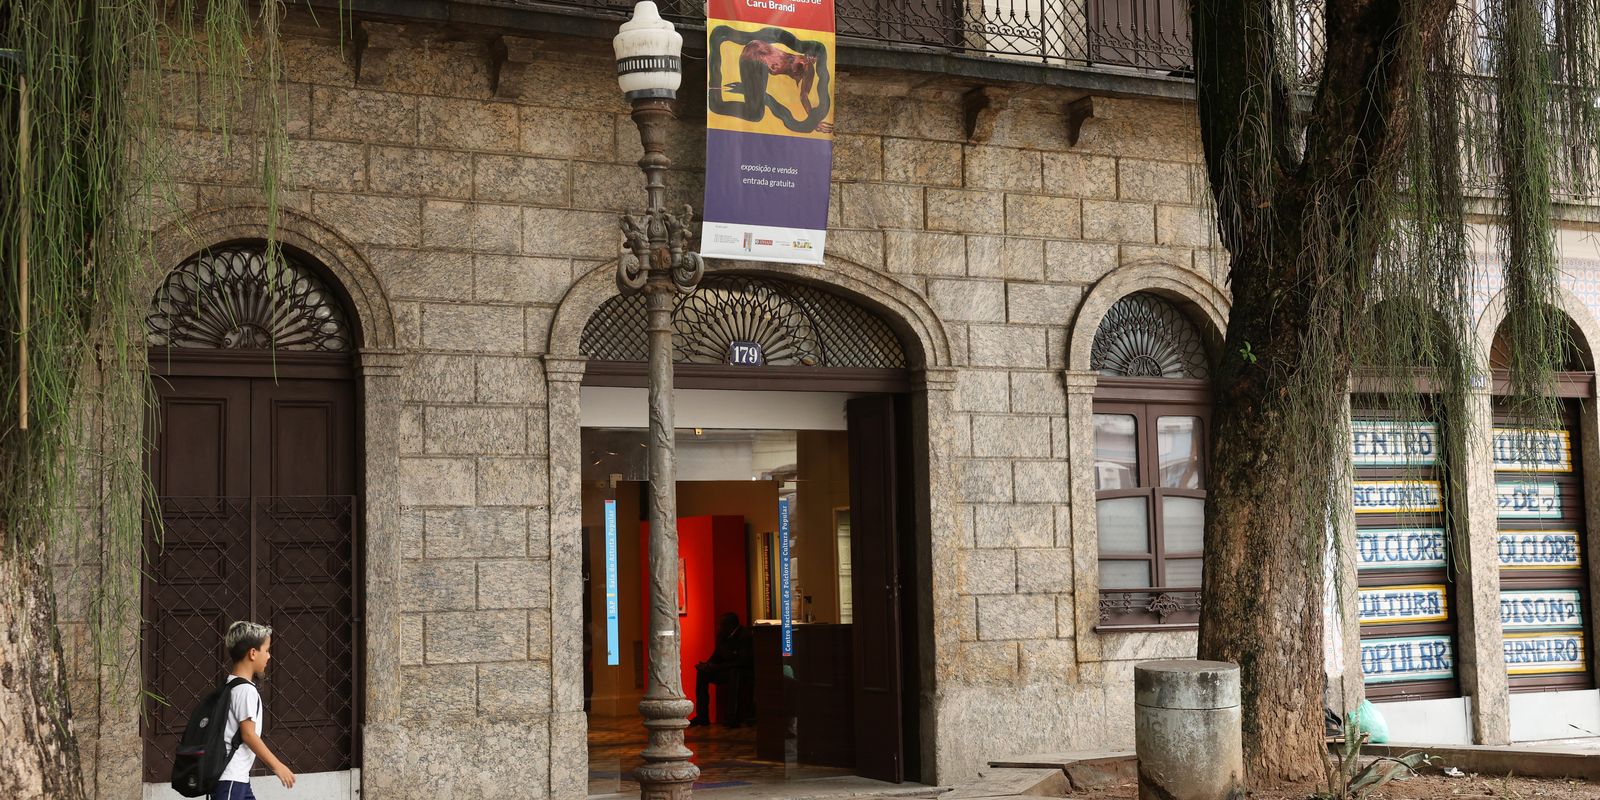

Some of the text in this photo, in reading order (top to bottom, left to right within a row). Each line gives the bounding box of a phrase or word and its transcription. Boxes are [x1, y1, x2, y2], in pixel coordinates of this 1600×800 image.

[746, 0, 767, 8] Caru
[768, 2, 795, 12] Brandi
[740, 164, 771, 173] exposição
[777, 167, 798, 175] vendas
[742, 178, 795, 188] entrada gratuita
[734, 346, 758, 364] 179
[1353, 431, 1432, 455] ENTRO
[1354, 486, 1438, 506] ACIONAL
[1513, 485, 1540, 511] DE
[608, 510, 616, 536] Popular
[1356, 532, 1443, 562] OLCLORE
[1498, 535, 1577, 563] OLCLORE
[784, 590, 790, 599] de
[1358, 592, 1441, 617] ULTURA
[1500, 596, 1565, 624] DISON
[1361, 641, 1450, 674] OPULAR
[1504, 638, 1578, 664] ARNEIRO
